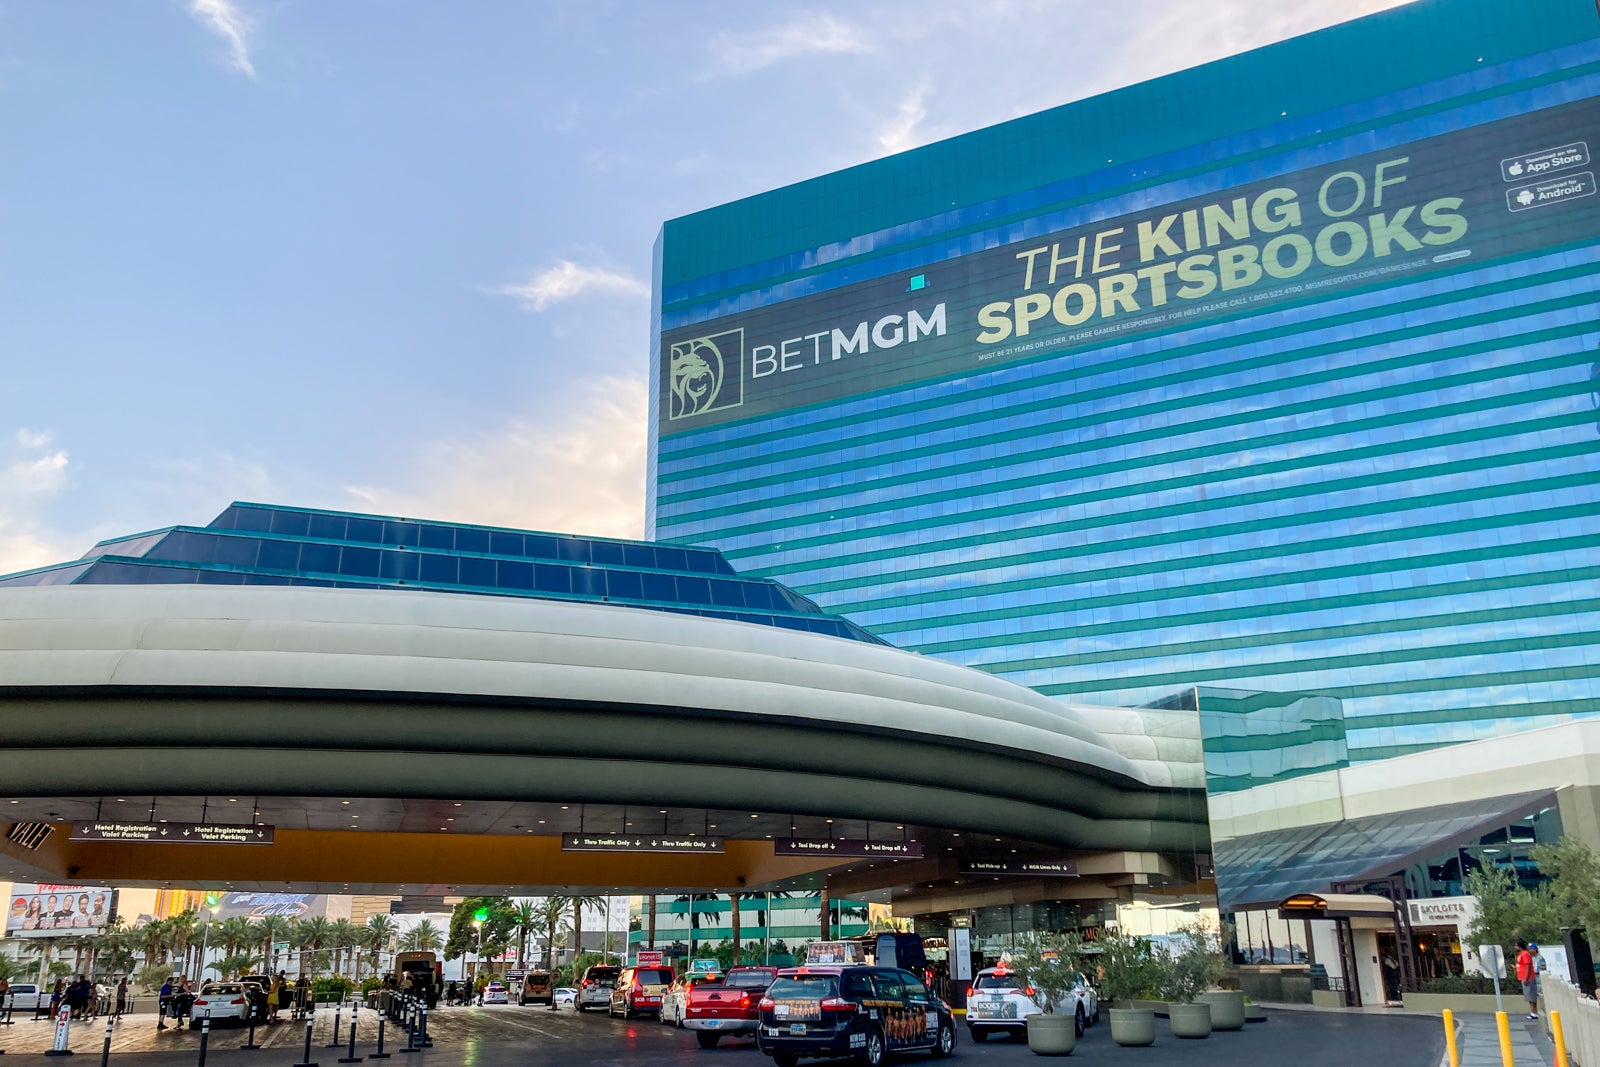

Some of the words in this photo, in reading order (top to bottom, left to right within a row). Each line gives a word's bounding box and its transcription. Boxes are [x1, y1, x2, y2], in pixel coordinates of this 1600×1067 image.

[1525, 152, 1556, 164] Download
[1527, 161, 1550, 173] App
[1551, 154, 1582, 167] Store
[1536, 181, 1567, 193] Download
[1015, 227, 1124, 290] THE
[1137, 187, 1302, 263] KING
[1318, 157, 1409, 218] OF
[976, 197, 1469, 344] SPORTSBOOKS
[978, 351, 996, 361] MUST
[1006, 348, 1013, 356] 21
[1013, 343, 1034, 353] YEARS
[1035, 341, 1044, 349] OR
[1068, 330, 1093, 341] PLEASE
[1093, 324, 1121, 336] GAMBLE
[1168, 311, 1181, 320] FOR
[1183, 306, 1201, 317] HELP
[1202, 301, 1228, 312] PLEASE
[1229, 297, 1248, 307] CALL
[752, 303, 947, 379] BETMGM
[94, 823, 114, 832] Hotel
[115, 824, 157, 833] Registration
[194, 826, 213, 834] Hotel
[213, 827, 254, 835] Registration
[9, 822, 57, 851] VALET
[101, 830, 120, 838] Valet
[121, 831, 149, 840] Parking
[219, 834, 247, 842] Parking
[616, 839, 630, 847] Only
[1421, 903, 1465, 914] SKYLOFTS
